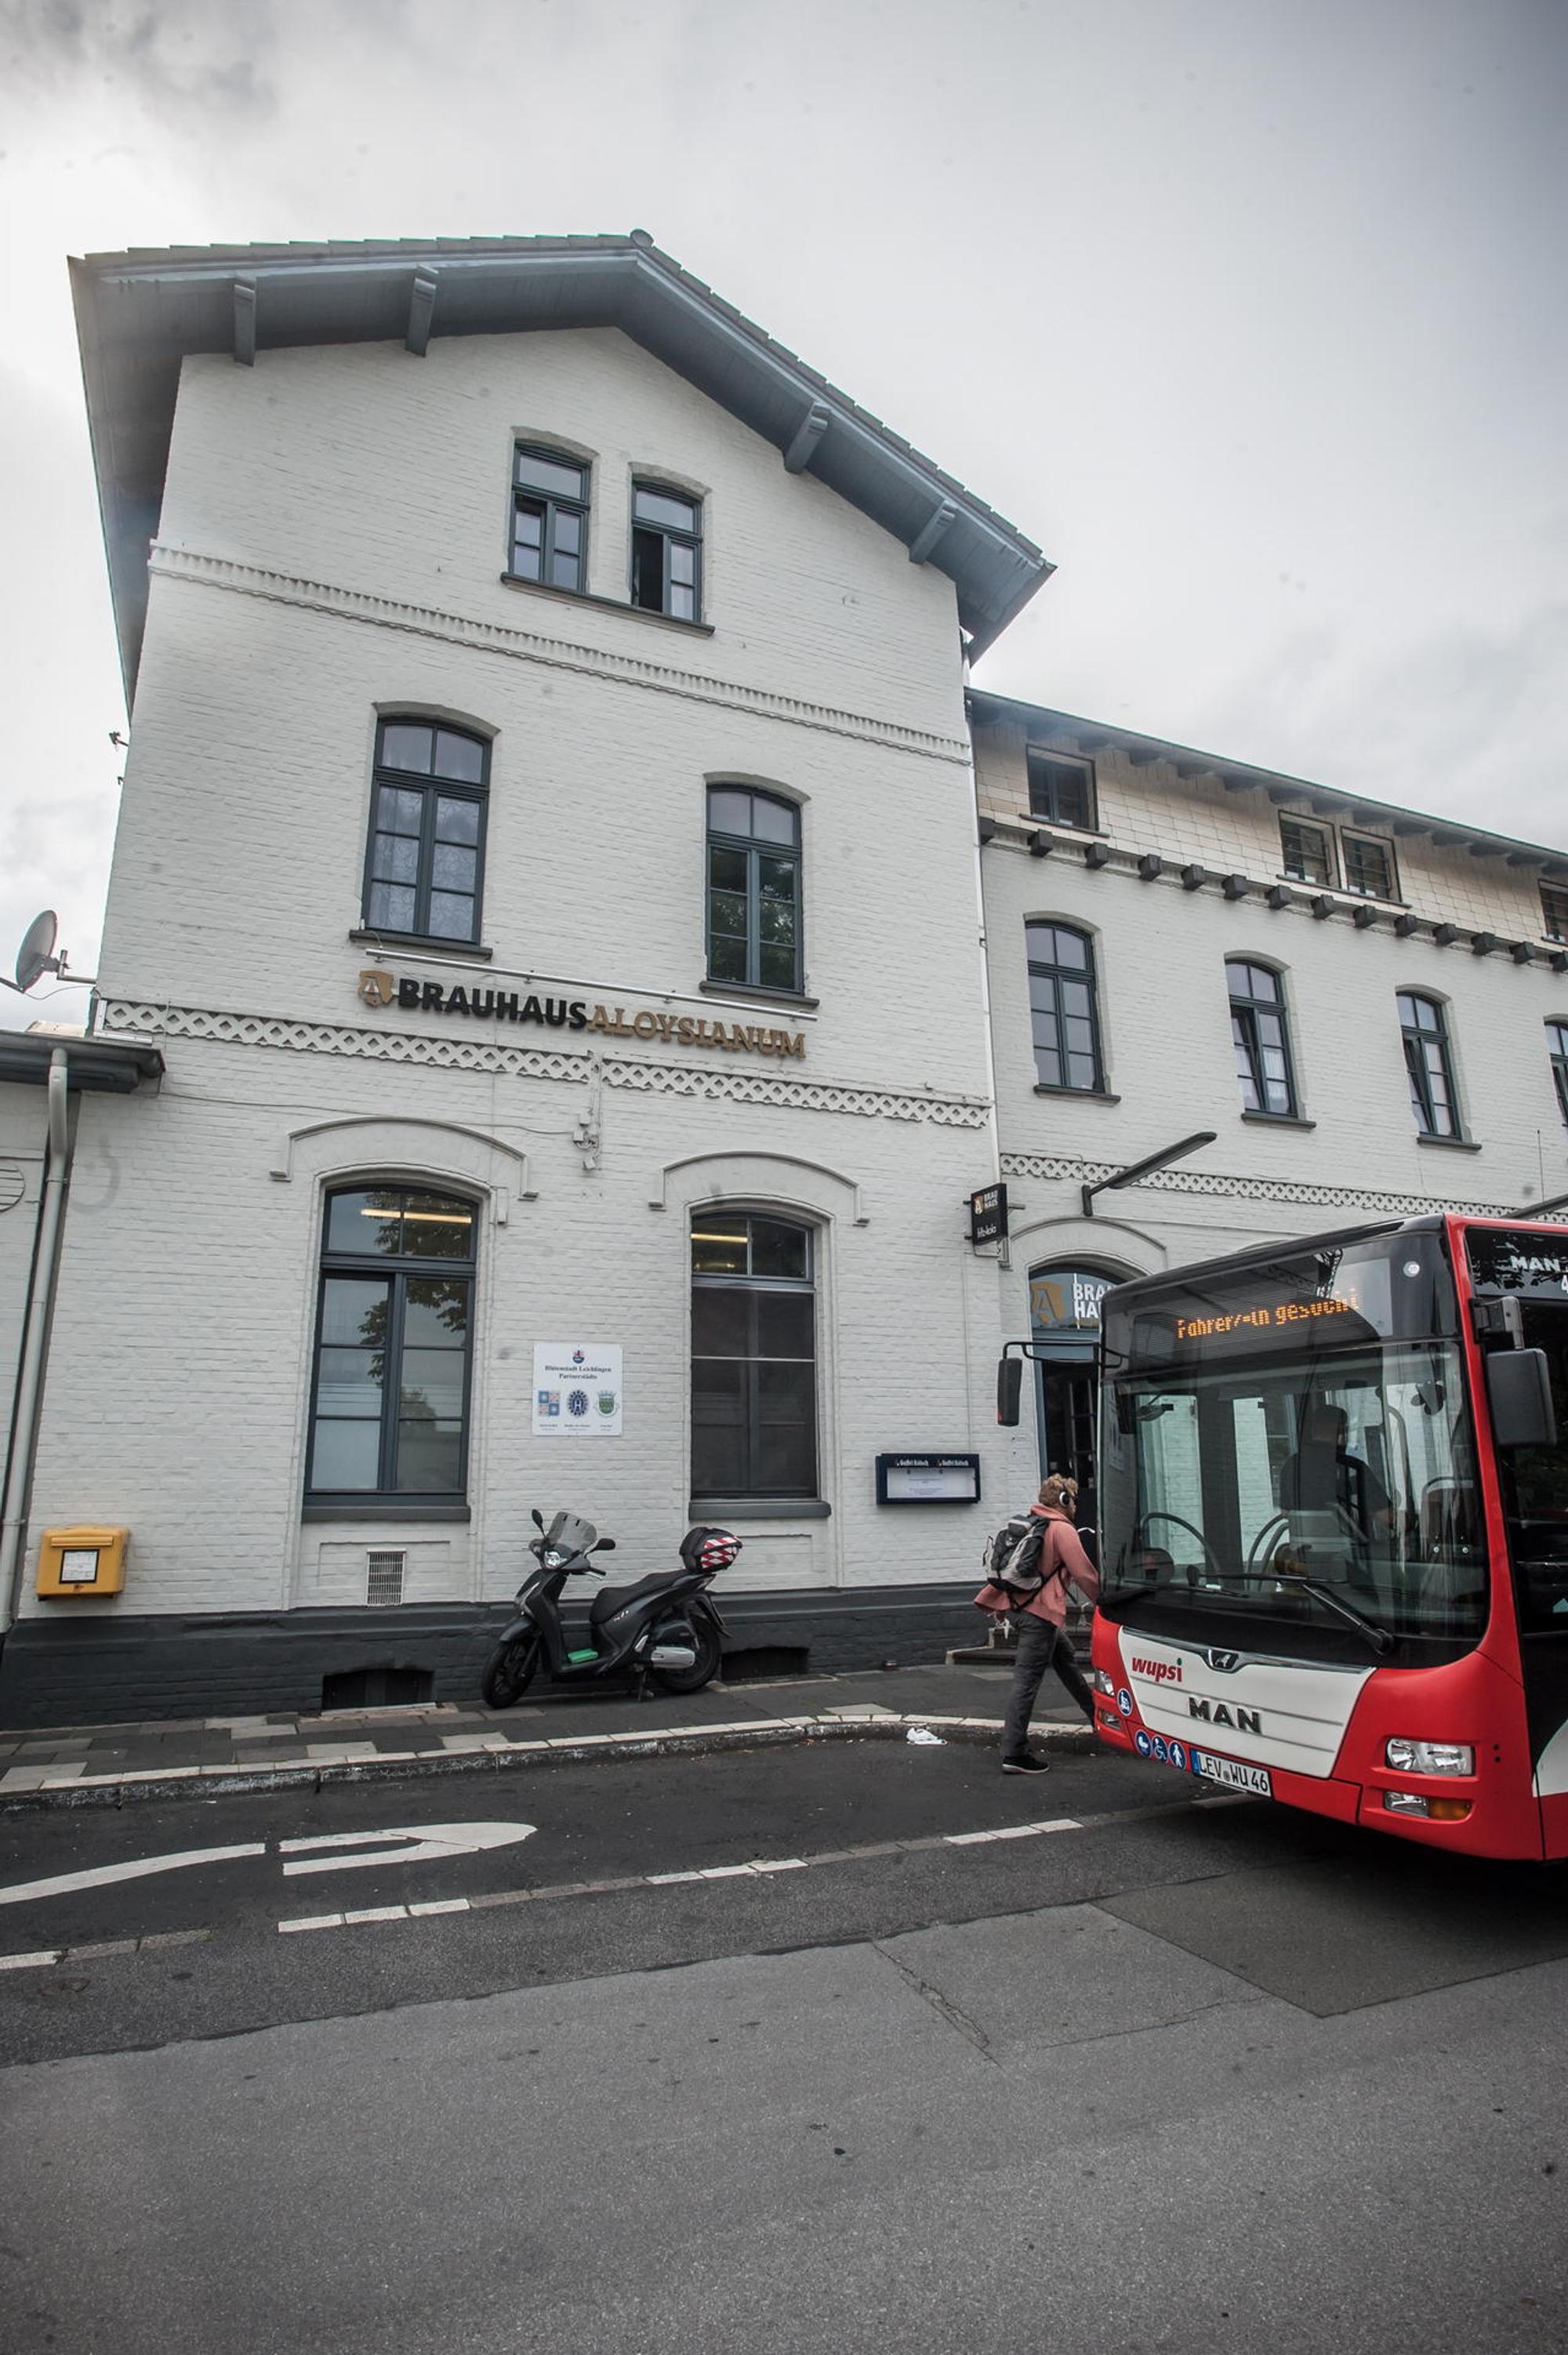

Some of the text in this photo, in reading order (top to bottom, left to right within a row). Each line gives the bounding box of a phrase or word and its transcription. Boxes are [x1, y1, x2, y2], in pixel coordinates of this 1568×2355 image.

[397, 978, 587, 1029] BRAUHAUS
[590, 1005, 806, 1058] ALOYSIANUM
[1510, 1255, 1561, 1272] MAN
[1073, 1283, 1113, 1301] BRA
[1276, 1288, 1361, 1325] gesucht
[1074, 1301, 1101, 1319] HA
[1132, 1657, 1182, 1682] wupsi
[1189, 1696, 1263, 1735] MAN
[1198, 1754, 1221, 1778] LEV
[1251, 1771, 1269, 1792] 46
